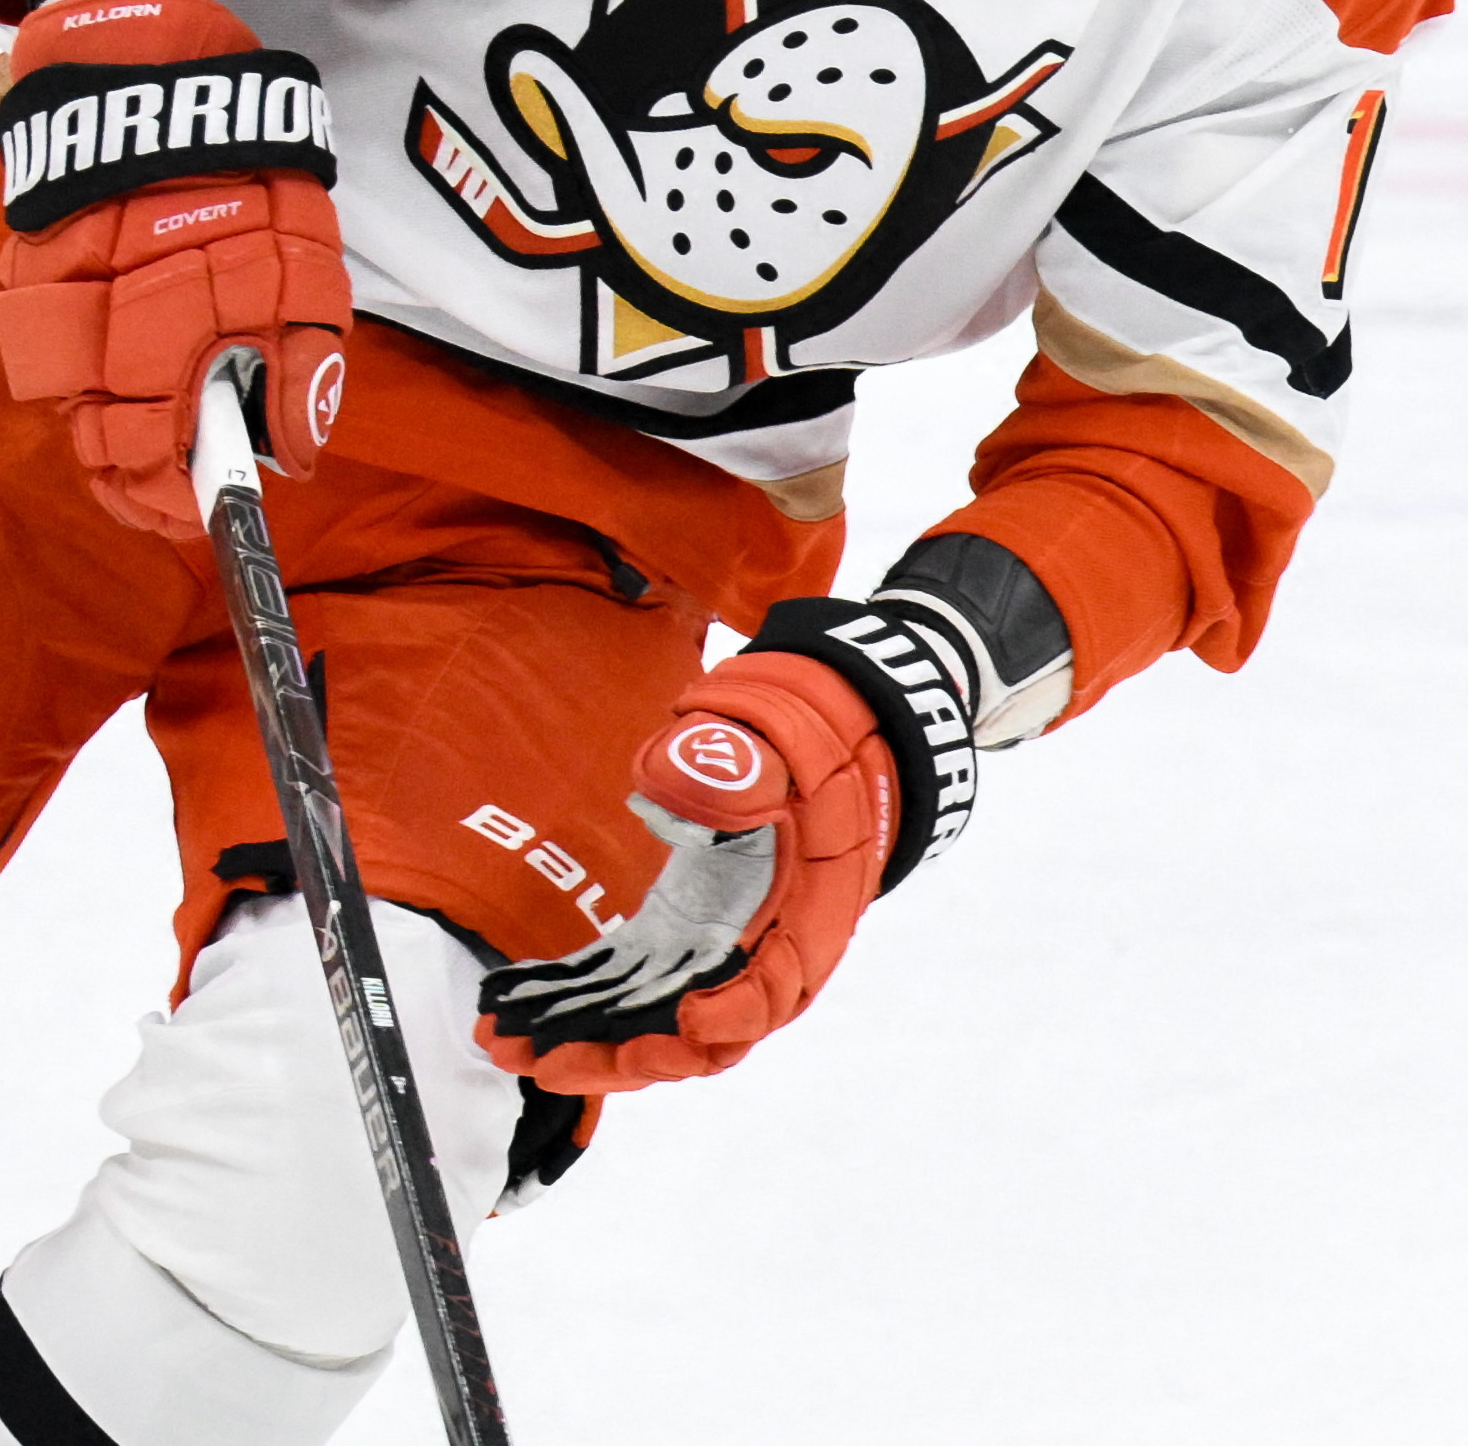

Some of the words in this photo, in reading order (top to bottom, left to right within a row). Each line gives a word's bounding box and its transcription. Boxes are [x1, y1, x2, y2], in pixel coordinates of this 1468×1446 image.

[62, 1, 162, 32] KILLORN
[153, 200, 243, 236] COVERT
[825, 614, 977, 862] WARR
[360, 976, 394, 1029] KILLORN
